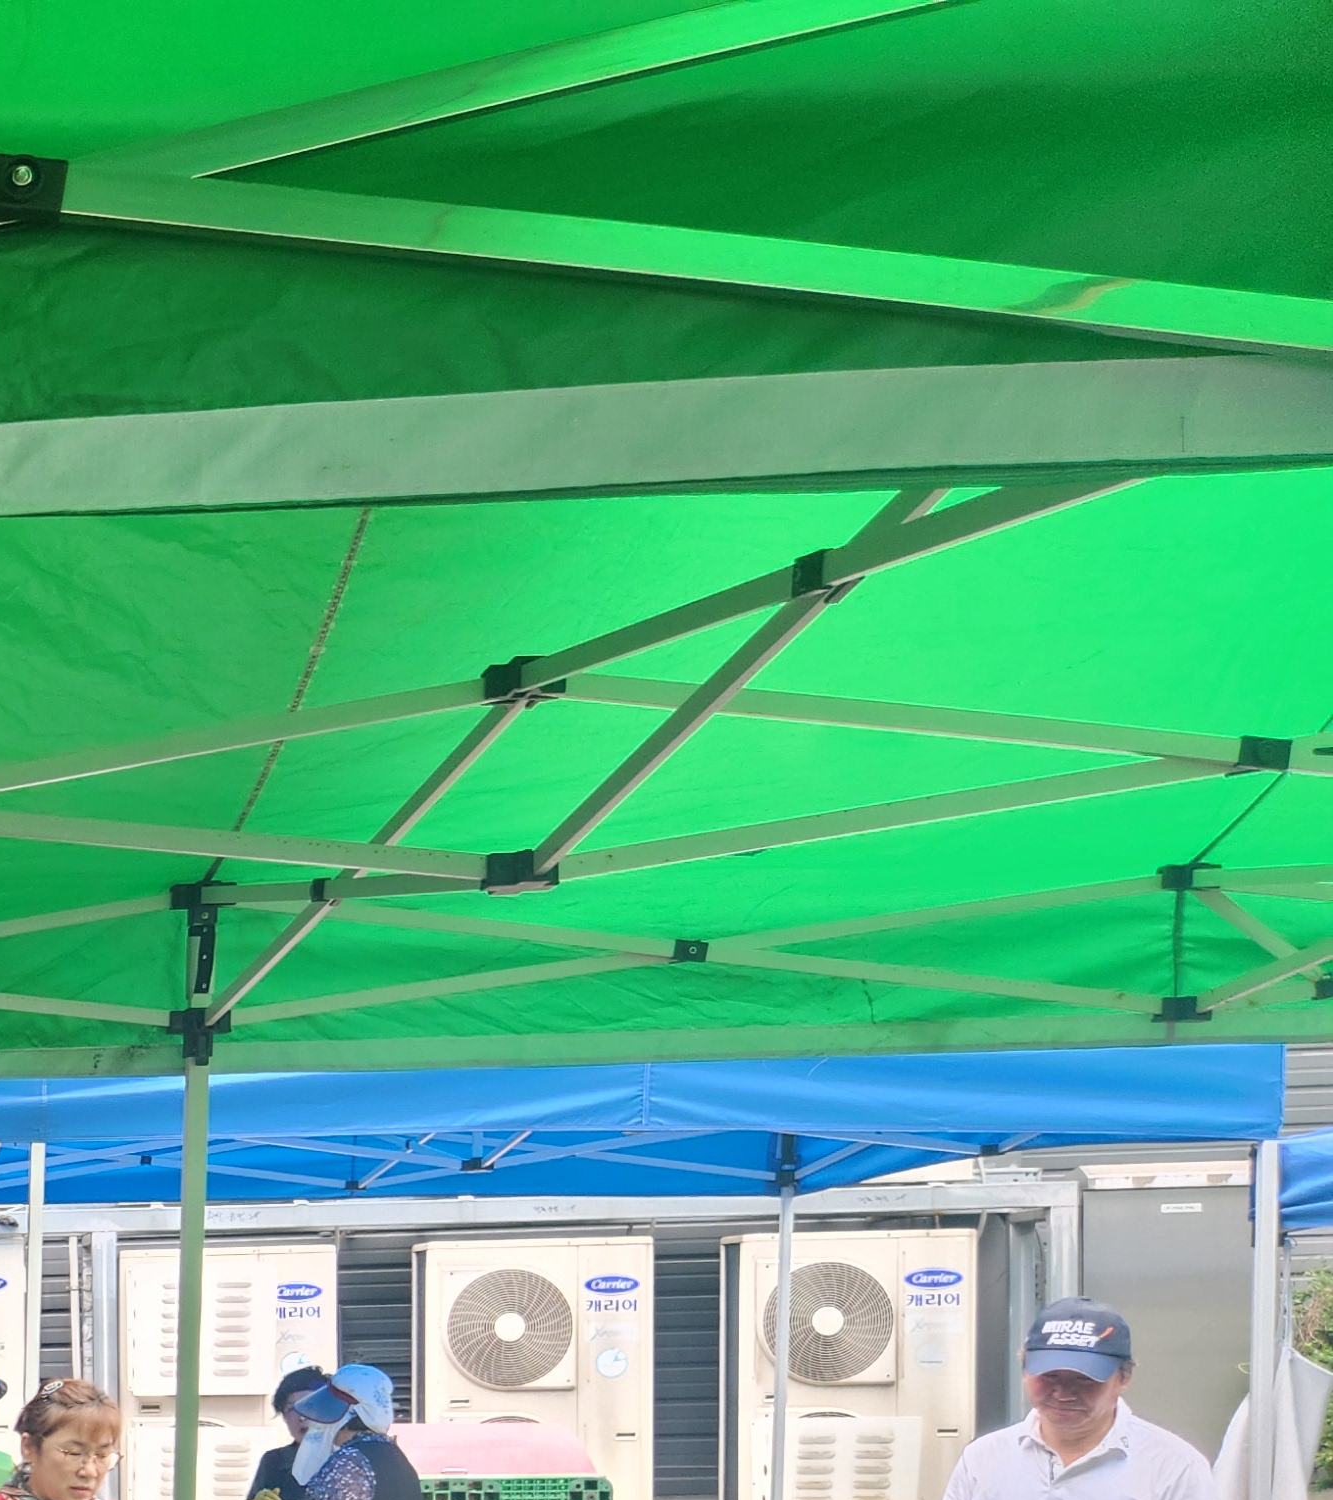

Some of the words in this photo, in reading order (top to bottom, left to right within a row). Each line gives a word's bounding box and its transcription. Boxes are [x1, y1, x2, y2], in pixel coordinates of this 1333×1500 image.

[589, 1278, 635, 1291] Carrier
[910, 1272, 959, 1285] Carrier
[585, 1298, 639, 1312] 캐리어
[905, 1292, 962, 1307] 캐리어
[1041, 1320, 1098, 1335] MIRAE
[1046, 1332, 1101, 1348] ASSET
